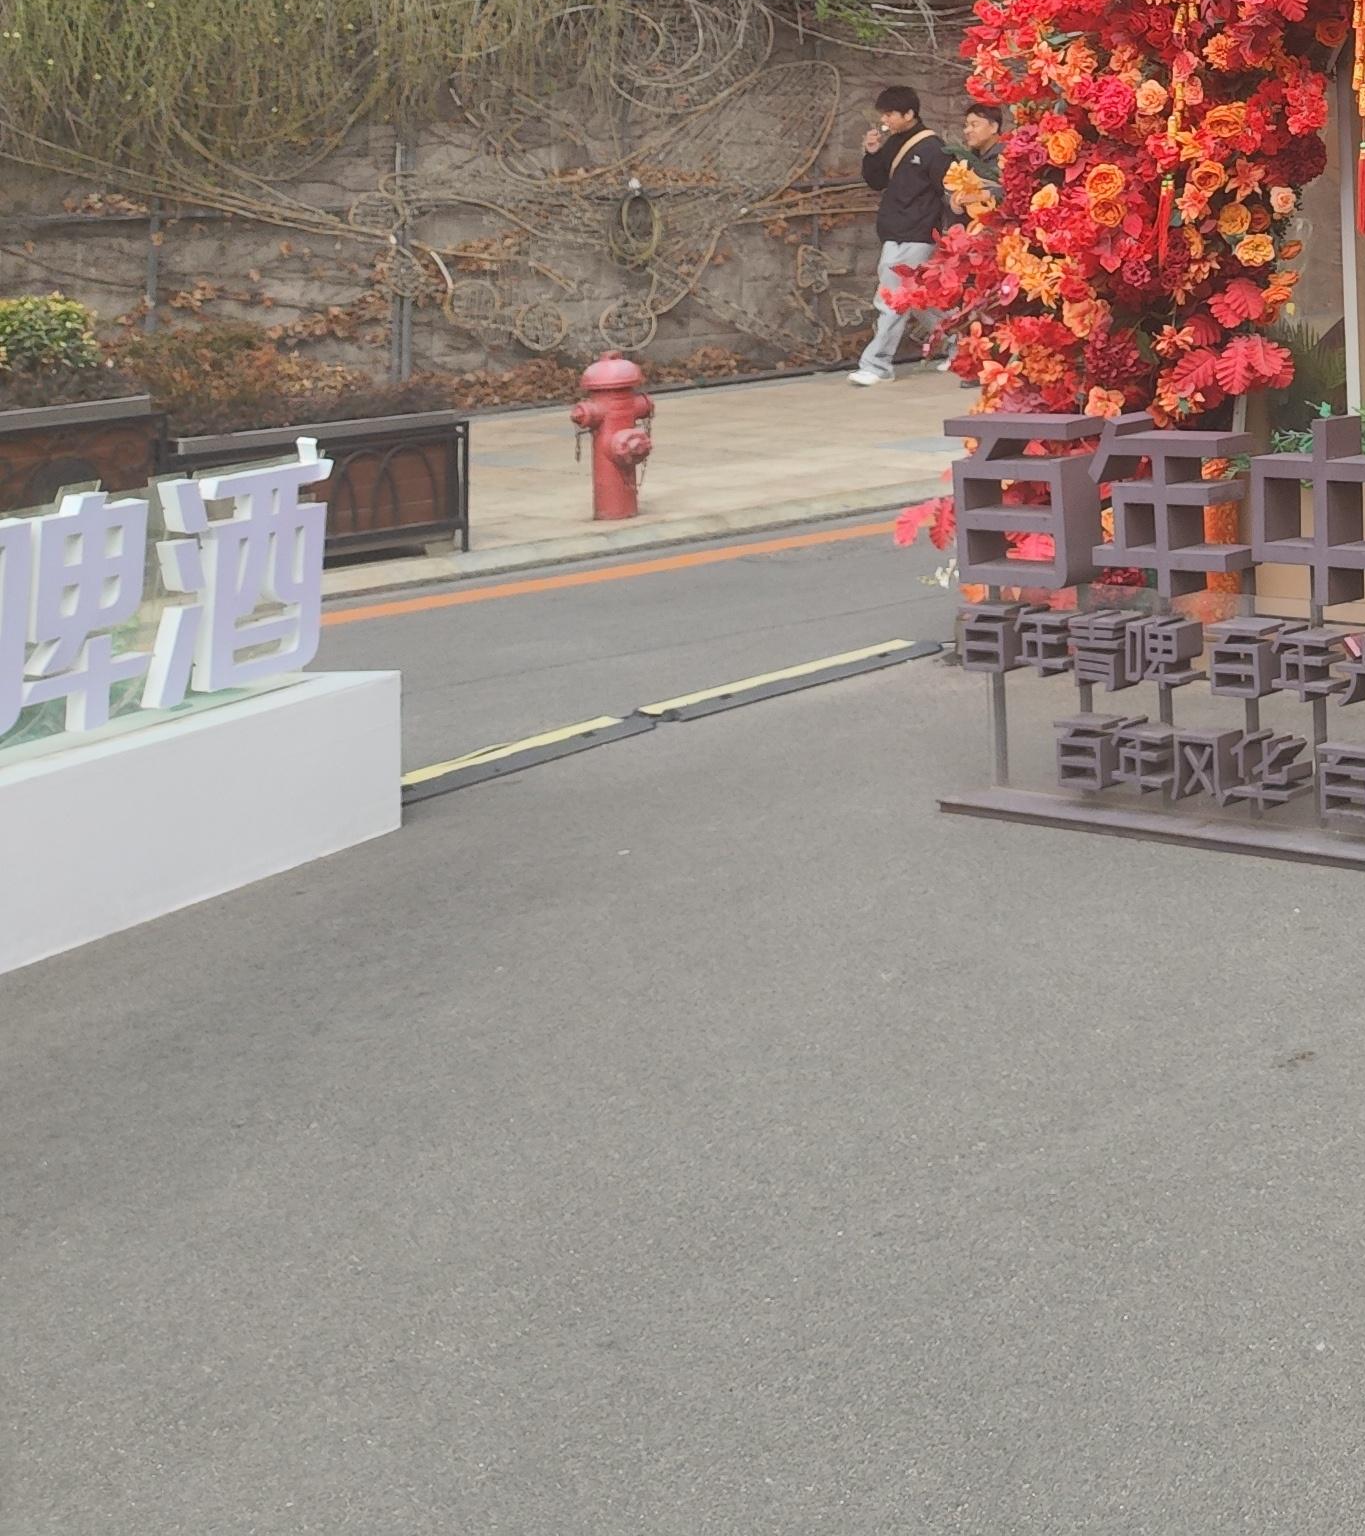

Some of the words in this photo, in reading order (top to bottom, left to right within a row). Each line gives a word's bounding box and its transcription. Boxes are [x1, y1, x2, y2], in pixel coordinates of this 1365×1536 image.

[958, 602, 1207, 693] 百年青啤
[1053, 714, 1315, 811] 百年风华
